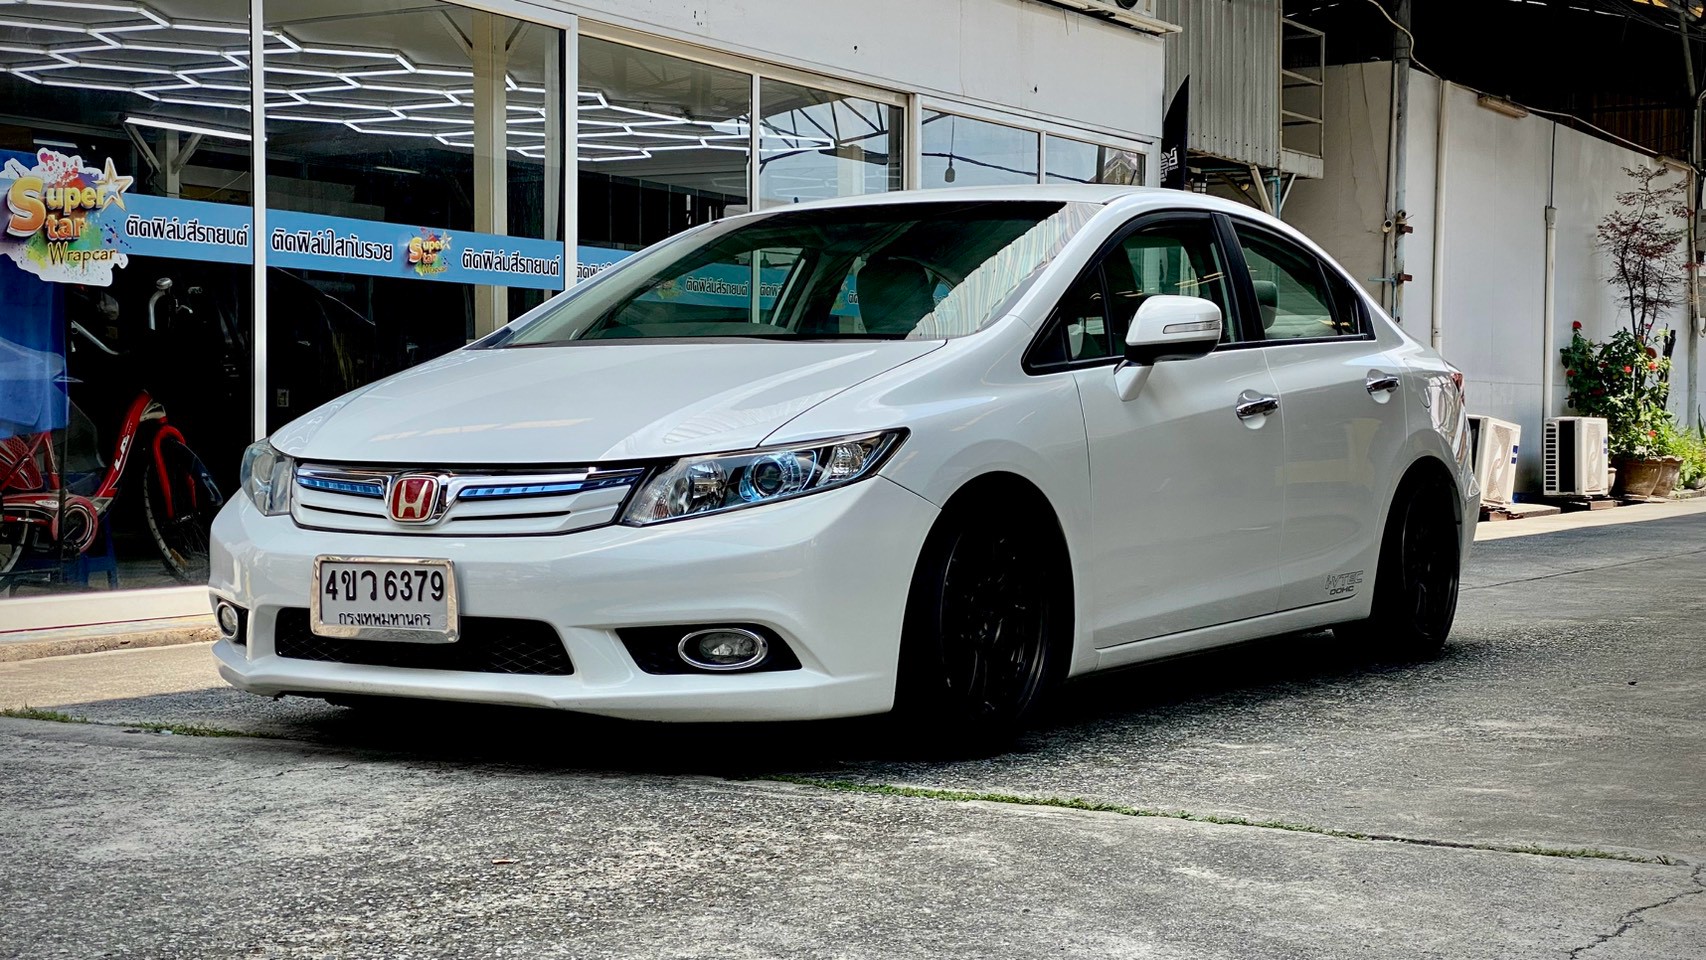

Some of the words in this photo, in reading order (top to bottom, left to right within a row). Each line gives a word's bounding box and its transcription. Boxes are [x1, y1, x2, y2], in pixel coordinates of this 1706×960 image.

[126, 215, 248, 246] ติดฟิล์มสีรถยนต์
[272, 229, 393, 261] ติดฟิล์มใสกันรอย
[48, 241, 117, 272] Wrapcar
[462, 249, 560, 276] ติดฟิล์มสีรถยนต์
[325, 570, 377, 601] 4ขว
[384, 570, 444, 601] 6379
